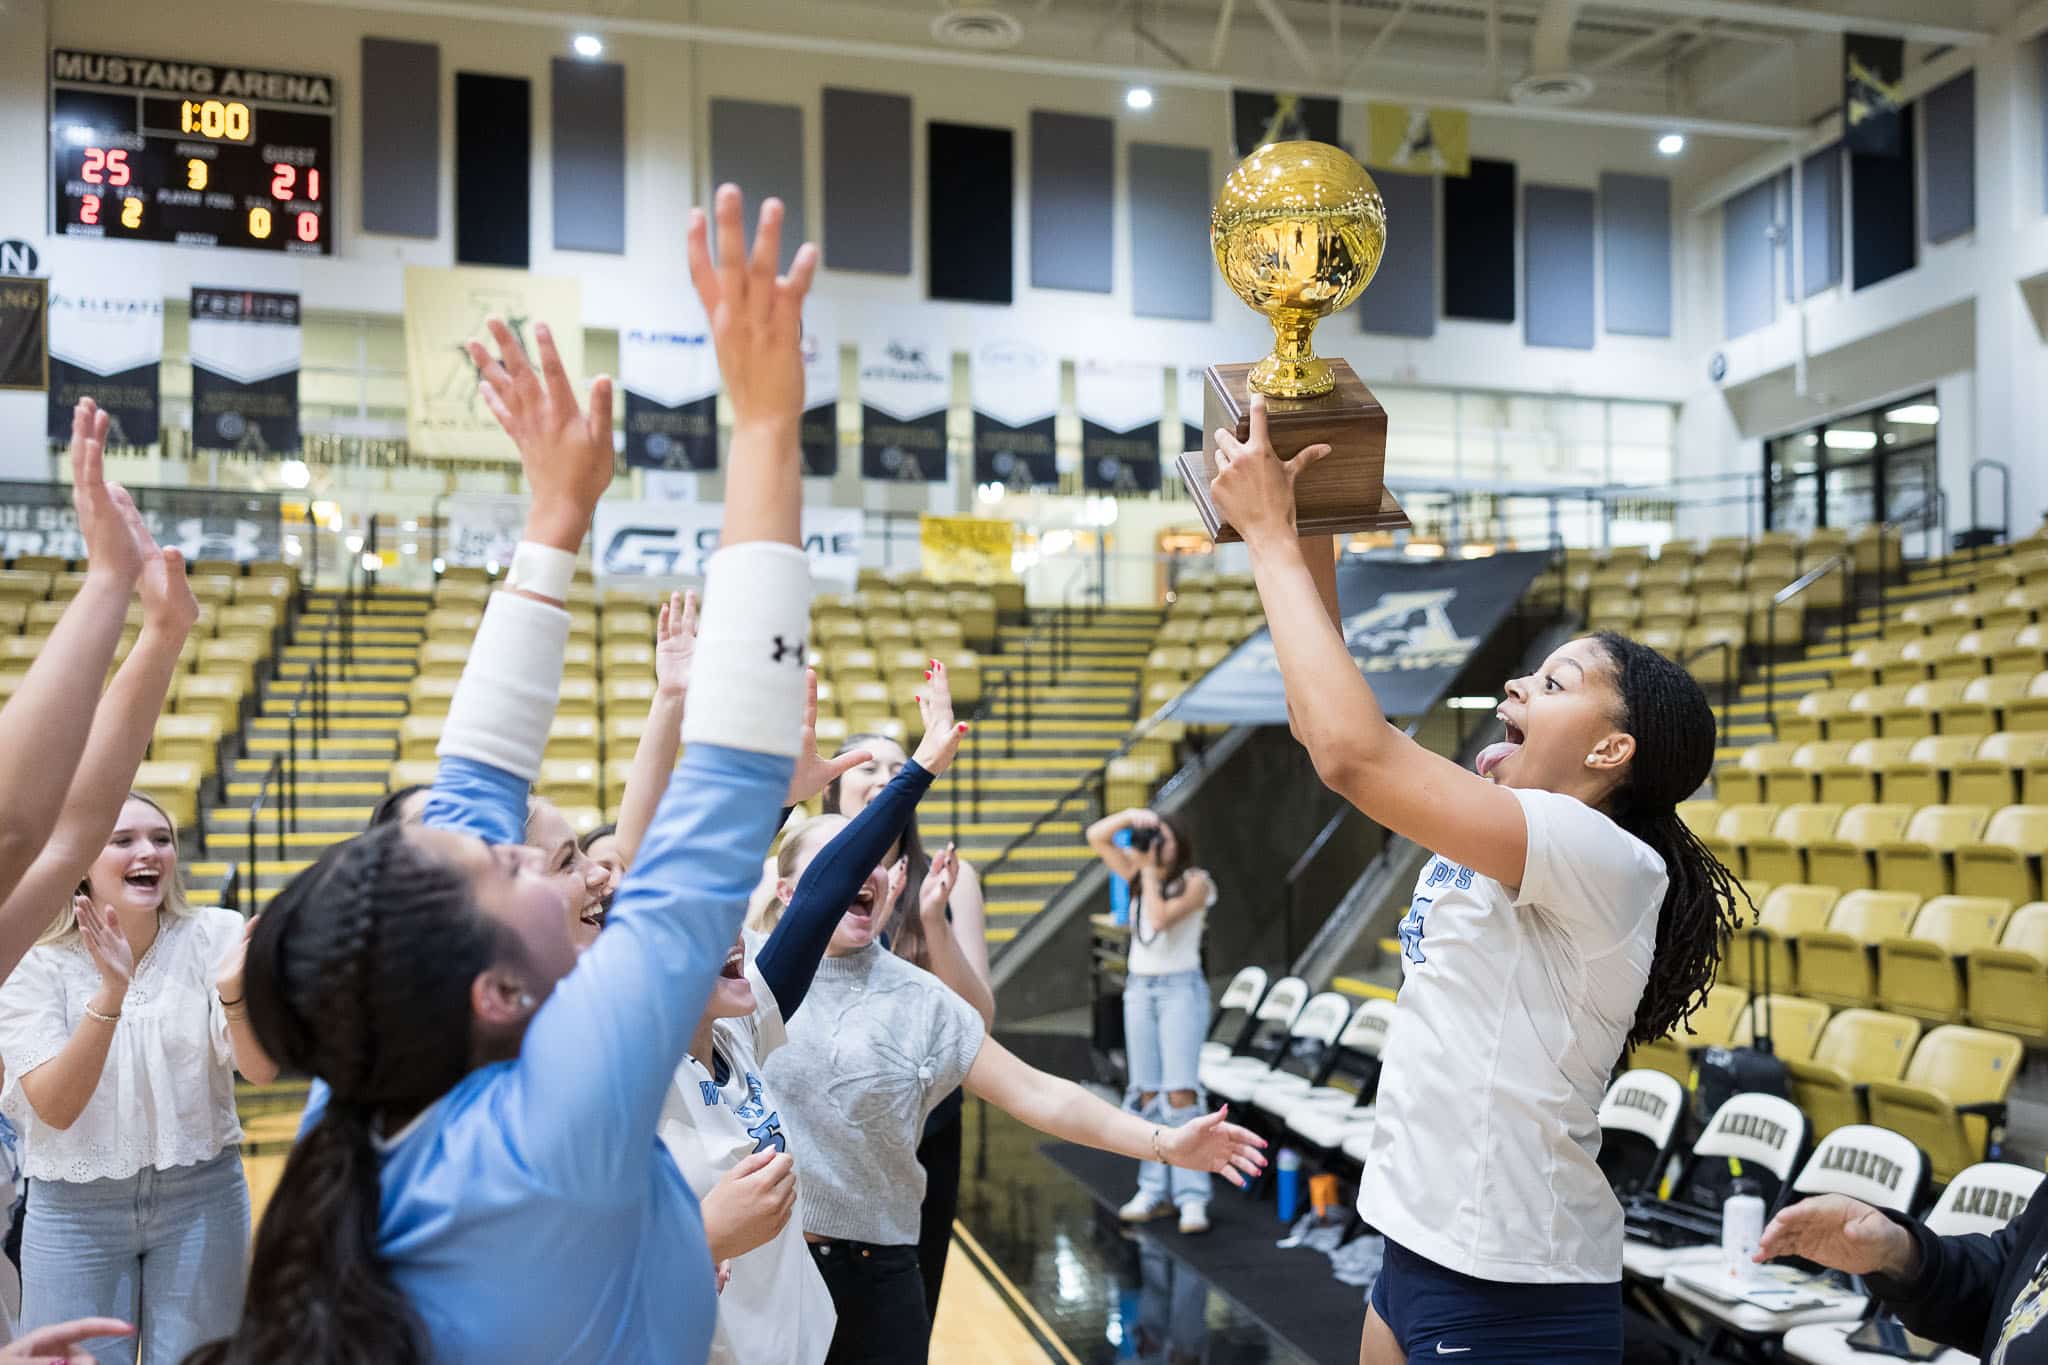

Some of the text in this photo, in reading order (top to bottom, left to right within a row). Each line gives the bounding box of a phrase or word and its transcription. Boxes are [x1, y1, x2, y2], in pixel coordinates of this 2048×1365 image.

[56, 52, 331, 103] MUSTANG ARENA
[181, 100, 250, 141] 1:00
[81, 147, 131, 187] 25
[186, 158, 208, 191] 3
[271, 163, 320, 201] 21
[79, 193, 101, 225] 2
[120, 197, 144, 229] 2
[249, 206, 272, 239] 0
[297, 211, 320, 242] 0
[1819, 1145, 1904, 1191] ANDREWS
